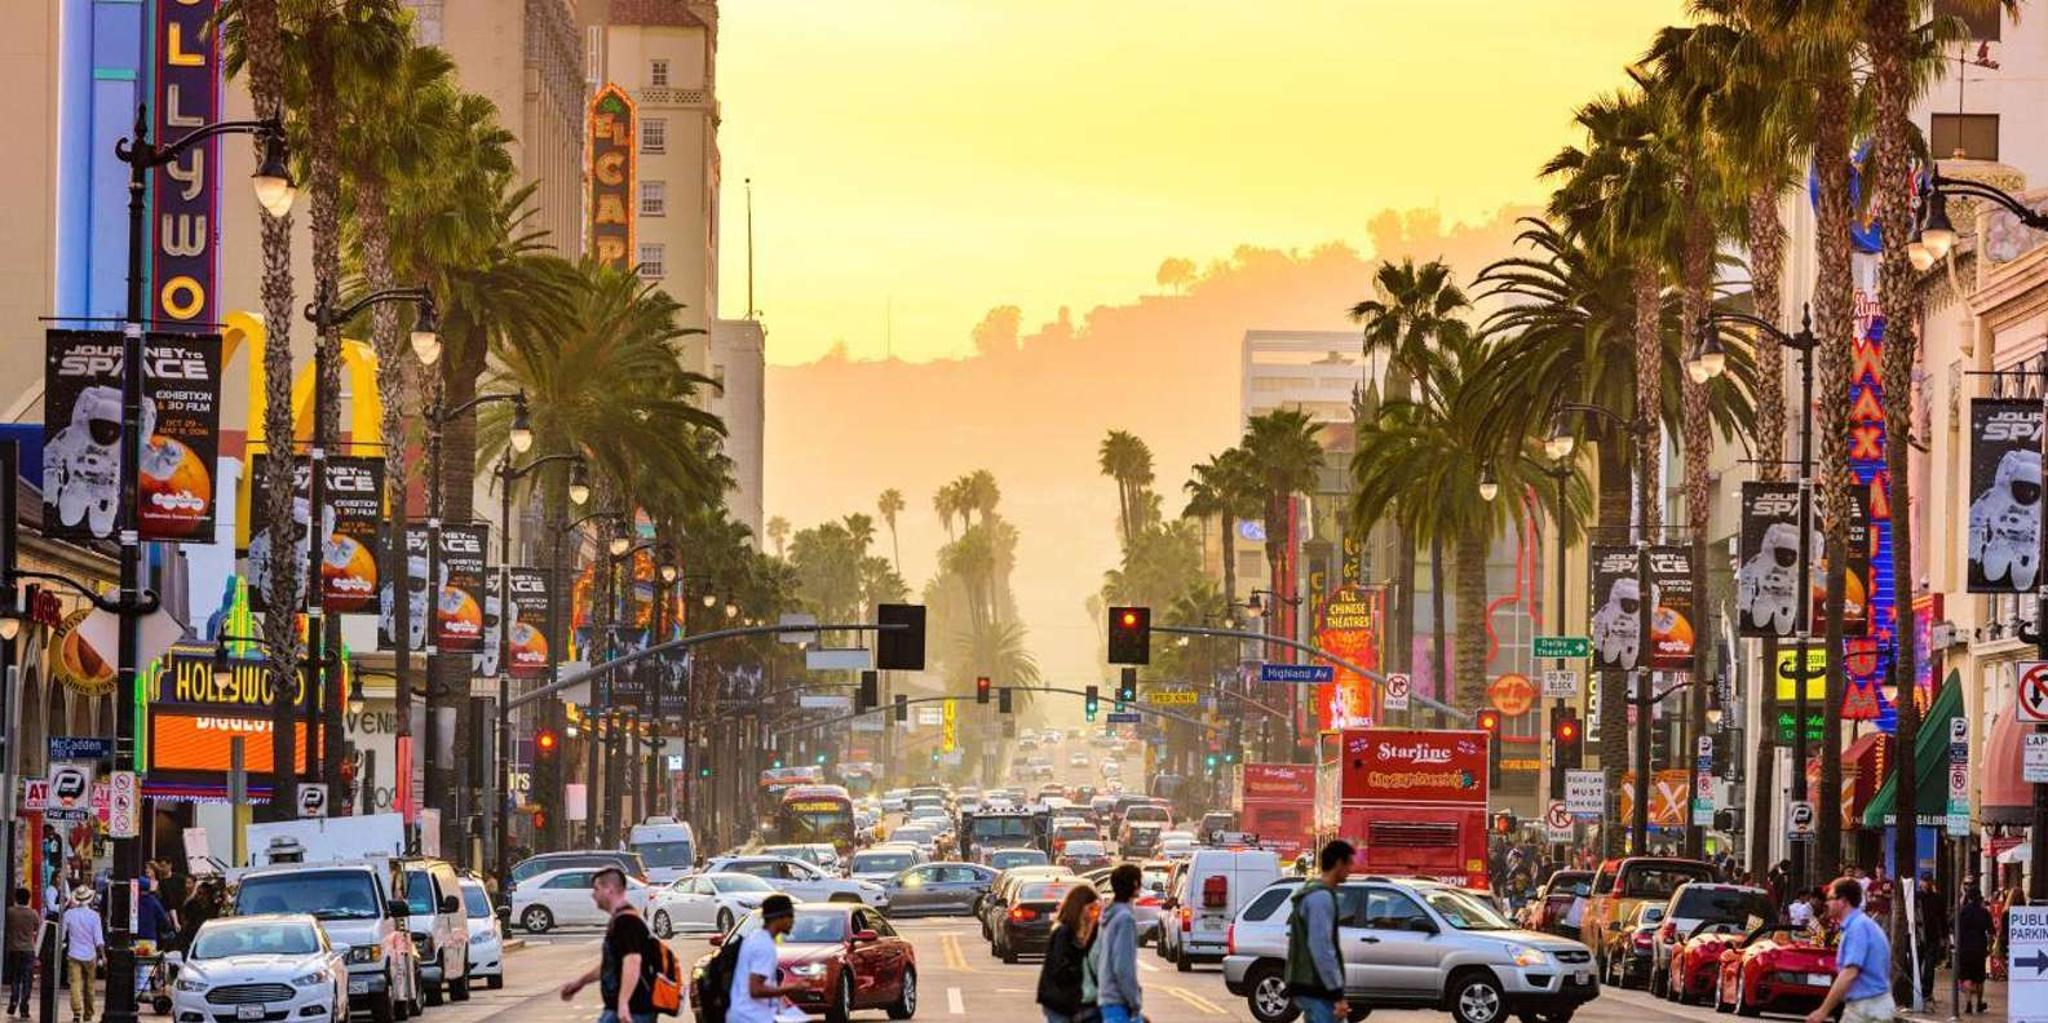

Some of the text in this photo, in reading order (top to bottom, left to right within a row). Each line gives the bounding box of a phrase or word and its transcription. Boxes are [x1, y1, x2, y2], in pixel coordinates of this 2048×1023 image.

[160, 0, 207, 320] LLYWO
[64, 344, 186, 359] JOURNEY
[58, 355, 209, 380] SPACE
[156, 389, 213, 401] EXHIBITION
[185, 402, 211, 413] FILM
[1329, 603, 1366, 616] CHINESE
[1326, 615, 1371, 628] THEATRES
[1268, 668, 1328, 680] Highland Av
[1377, 742, 1453, 763] Starline
[1571, 788, 1602, 796] MUST
